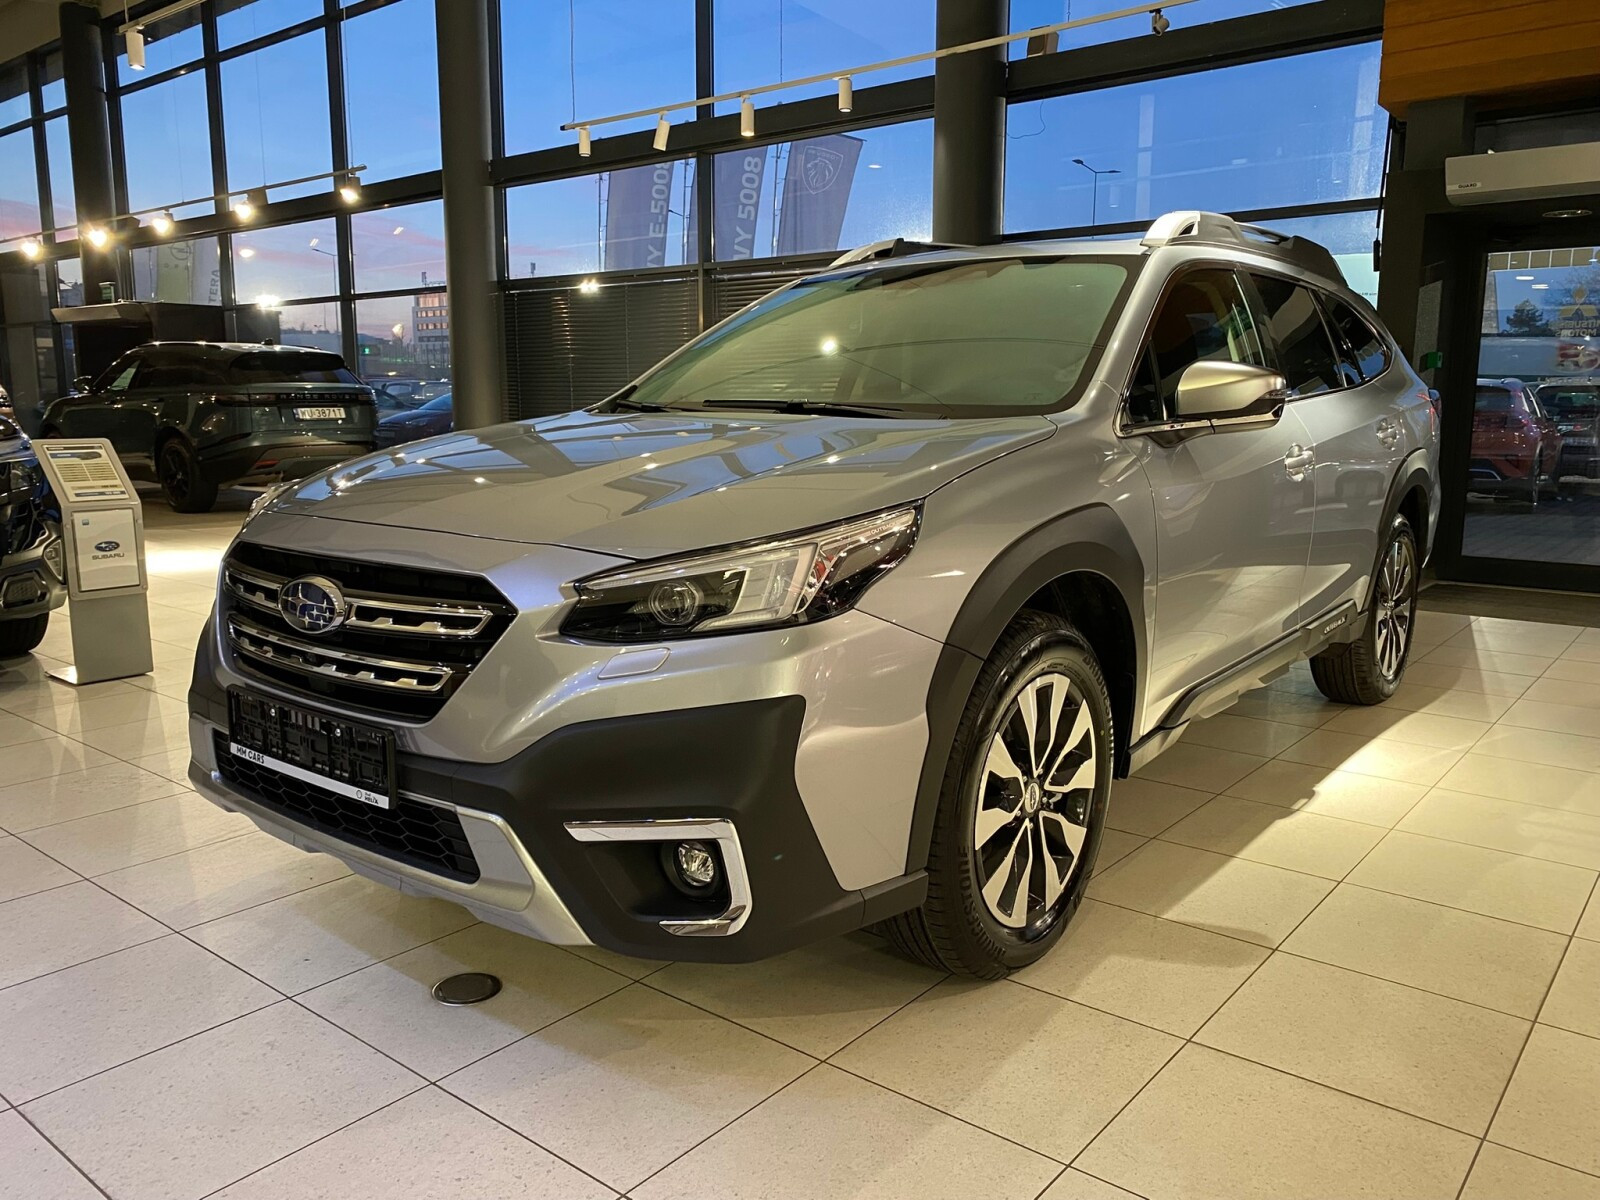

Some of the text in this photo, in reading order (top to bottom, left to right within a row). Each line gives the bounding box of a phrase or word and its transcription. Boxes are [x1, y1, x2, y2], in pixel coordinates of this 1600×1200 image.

[737, 156, 762, 221] 5008
[92, 552, 125, 560] SUBARU
[236, 745, 265, 765] MM CARS
